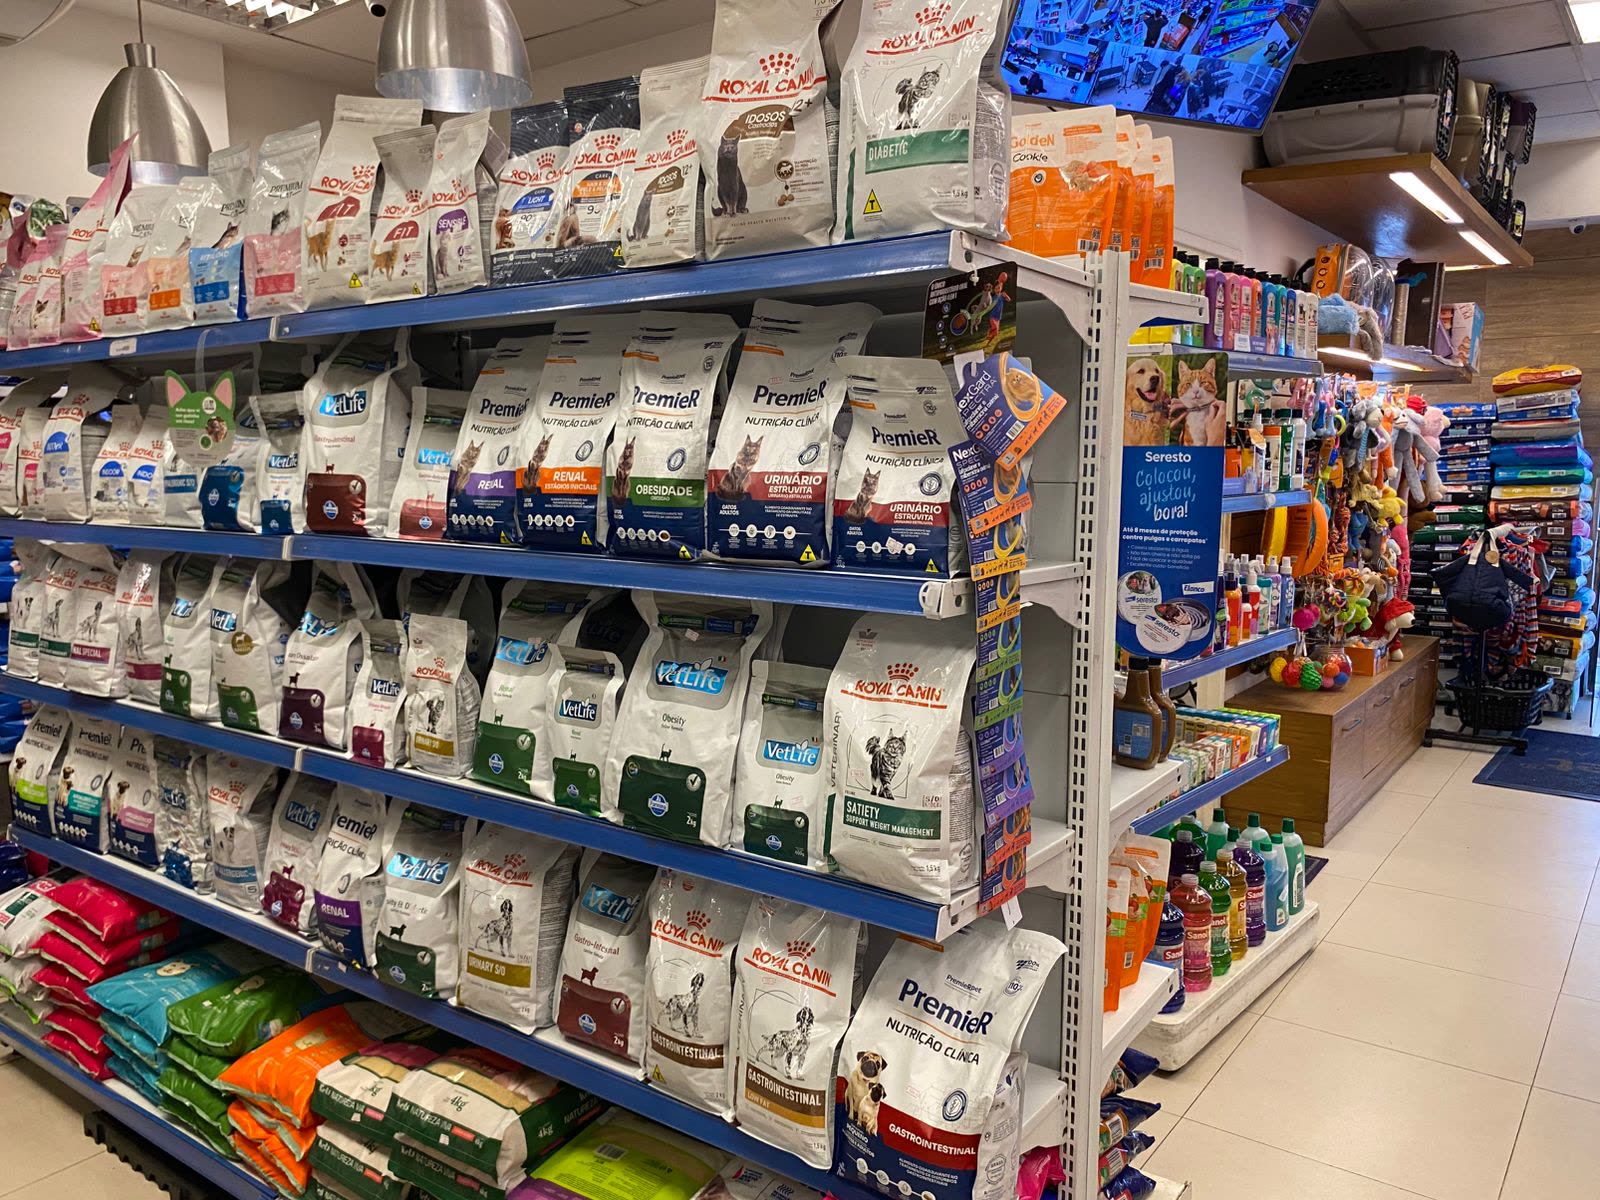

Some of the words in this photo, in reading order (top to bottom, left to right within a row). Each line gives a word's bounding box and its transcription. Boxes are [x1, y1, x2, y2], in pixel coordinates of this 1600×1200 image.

[719, 78, 769, 96] ROYAL
[745, 111, 786, 123] IDOSOS
[606, 148, 637, 164] CANIN
[868, 140, 909, 162] DIABETIC
[1012, 152, 1048, 163] Cookie
[393, 225, 412, 237] FIT
[753, 380, 827, 407] PremieR
[958, 370, 992, 412] exGard
[963, 377, 997, 419] PECTRA
[325, 393, 366, 416] VetLife
[549, 391, 617, 410] PremieR
[470, 423, 503, 436] NUTRIÇÃO
[542, 417, 579, 429] NUTRIÇÃO
[664, 420, 694, 431] CLÍNICA
[745, 415, 793, 428] NUTRIÇÃO
[872, 426, 941, 447] PremieR
[865, 454, 912, 468] NUTRIÇÃO
[1145, 451, 1192, 463] Seresto
[477, 478, 504, 490] RENAL
[553, 471, 588, 483] RENAL
[764, 472, 823, 486] URINÁRIO
[1136, 467, 1197, 488] Colocou,
[635, 484, 693, 497] OBESIDADE
[768, 485, 813, 495] ESTRUVITA
[1139, 485, 1196, 512] ajustou,
[889, 502, 942, 514] URINÁRIO
[1153, 501, 1189, 522] bora!
[894, 512, 934, 522] ESTRUVITA
[1143, 535, 1166, 543] pulgas
[1169, 529, 1199, 537] proteção
[1183, 585, 1206, 593] Elanco
[1136, 596, 1158, 604] seresto
[1154, 619, 1180, 638] seresto
[657, 664, 722, 693] VetLife
[372, 679, 400, 696] VetLife
[855, 680, 894, 696] ROYAL
[895, 683, 944, 702] CANIN
[563, 701, 597, 720] VetLife
[661, 713, 686, 726] Obesity
[767, 741, 817, 764] VetLife
[831, 711, 842, 788] VETERINAR
[775, 773, 795, 783] Obesity
[286, 802, 321, 830] VetLife
[846, 801, 881, 818] SATIETY
[336, 812, 377, 839] emieR
[686, 815, 697, 829] 2kg
[846, 815, 869, 828] SUPPORT
[869, 820, 890, 832] WEIGHT
[891, 824, 934, 838] MANAGEMENT
[327, 837, 346, 851] RIÇÃO
[391, 852, 448, 883] VetLife
[320, 904, 350, 918] RENAL
[1211, 917, 1226, 926] anol
[654, 919, 687, 942] ROYAL
[1187, 931, 1209, 940] Sanol
[752, 946, 790, 971] ROYAL
[898, 978, 994, 1036] PremieR
[613, 1036, 625, 1047] 2kg
[885, 1017, 942, 1054] NUTRIÇÃO
[651, 1031, 720, 1060] GASTROINTESTINAL
[747, 1067, 822, 1107] GASTROINTESTINAL
[449, 1094, 467, 1112] 4kg
[760, 1097, 771, 1108] FAT
[537, 1125, 554, 1138] 4kg
[888, 1123, 977, 1156] GASTROINTESTINAL
